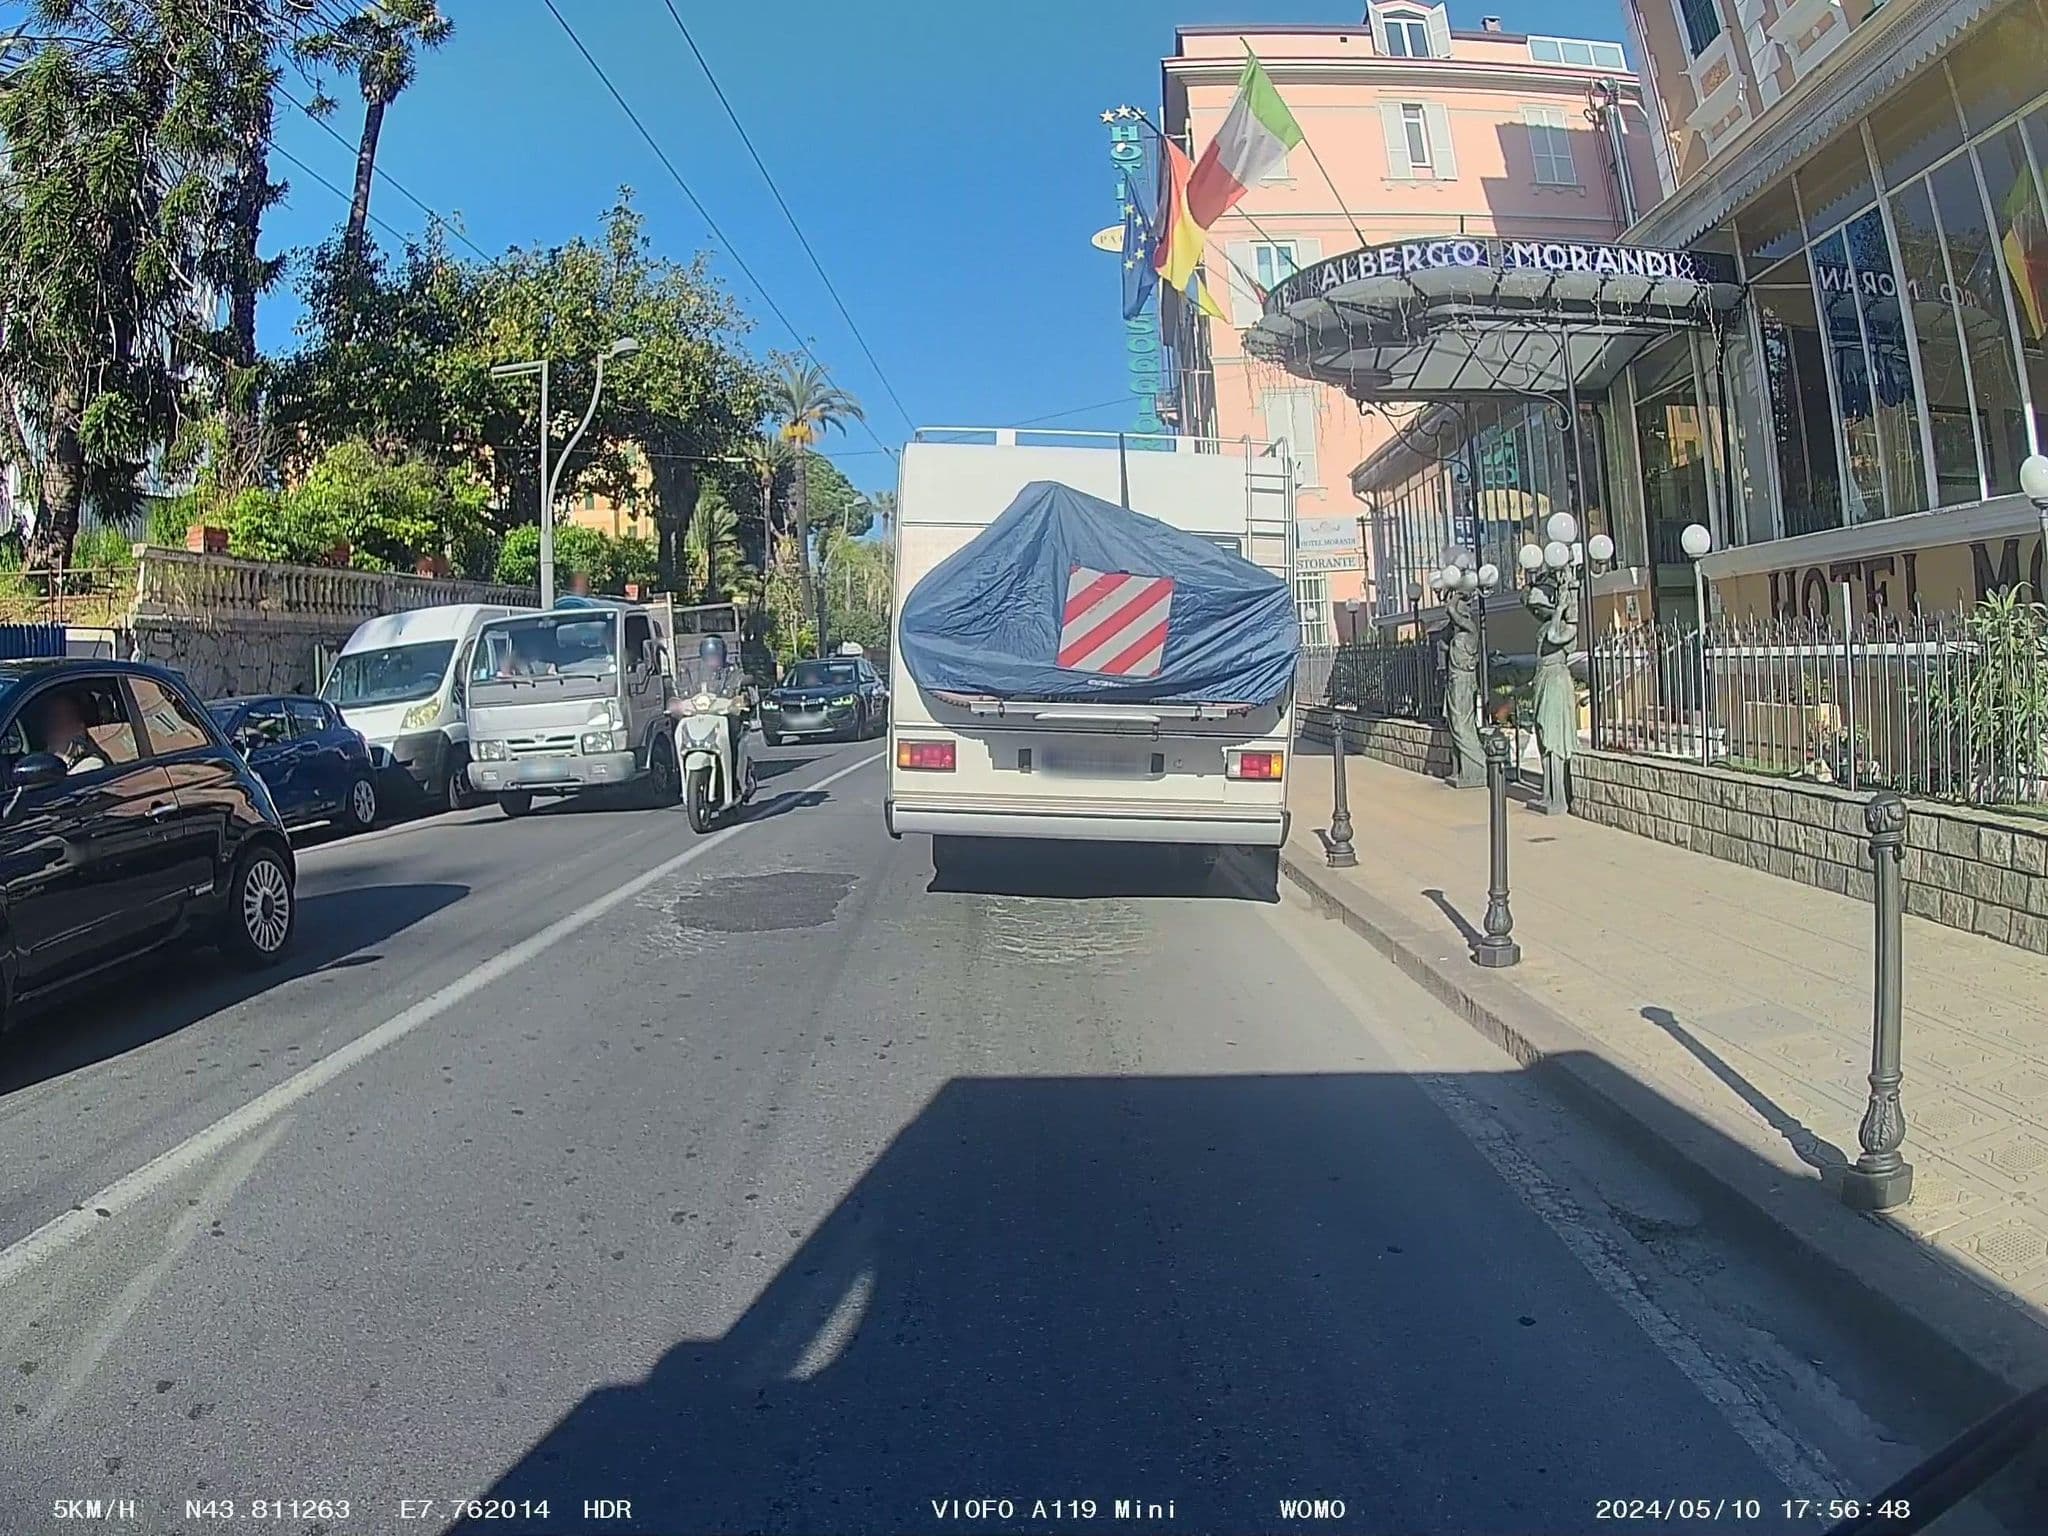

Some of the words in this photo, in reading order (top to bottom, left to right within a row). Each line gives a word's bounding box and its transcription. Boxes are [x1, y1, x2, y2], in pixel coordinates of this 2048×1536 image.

[1320, 239, 1480, 291] ALBERGO
[1511, 241, 1680, 280] MORANDI
[1768, 552, 1940, 634] HOTEL
